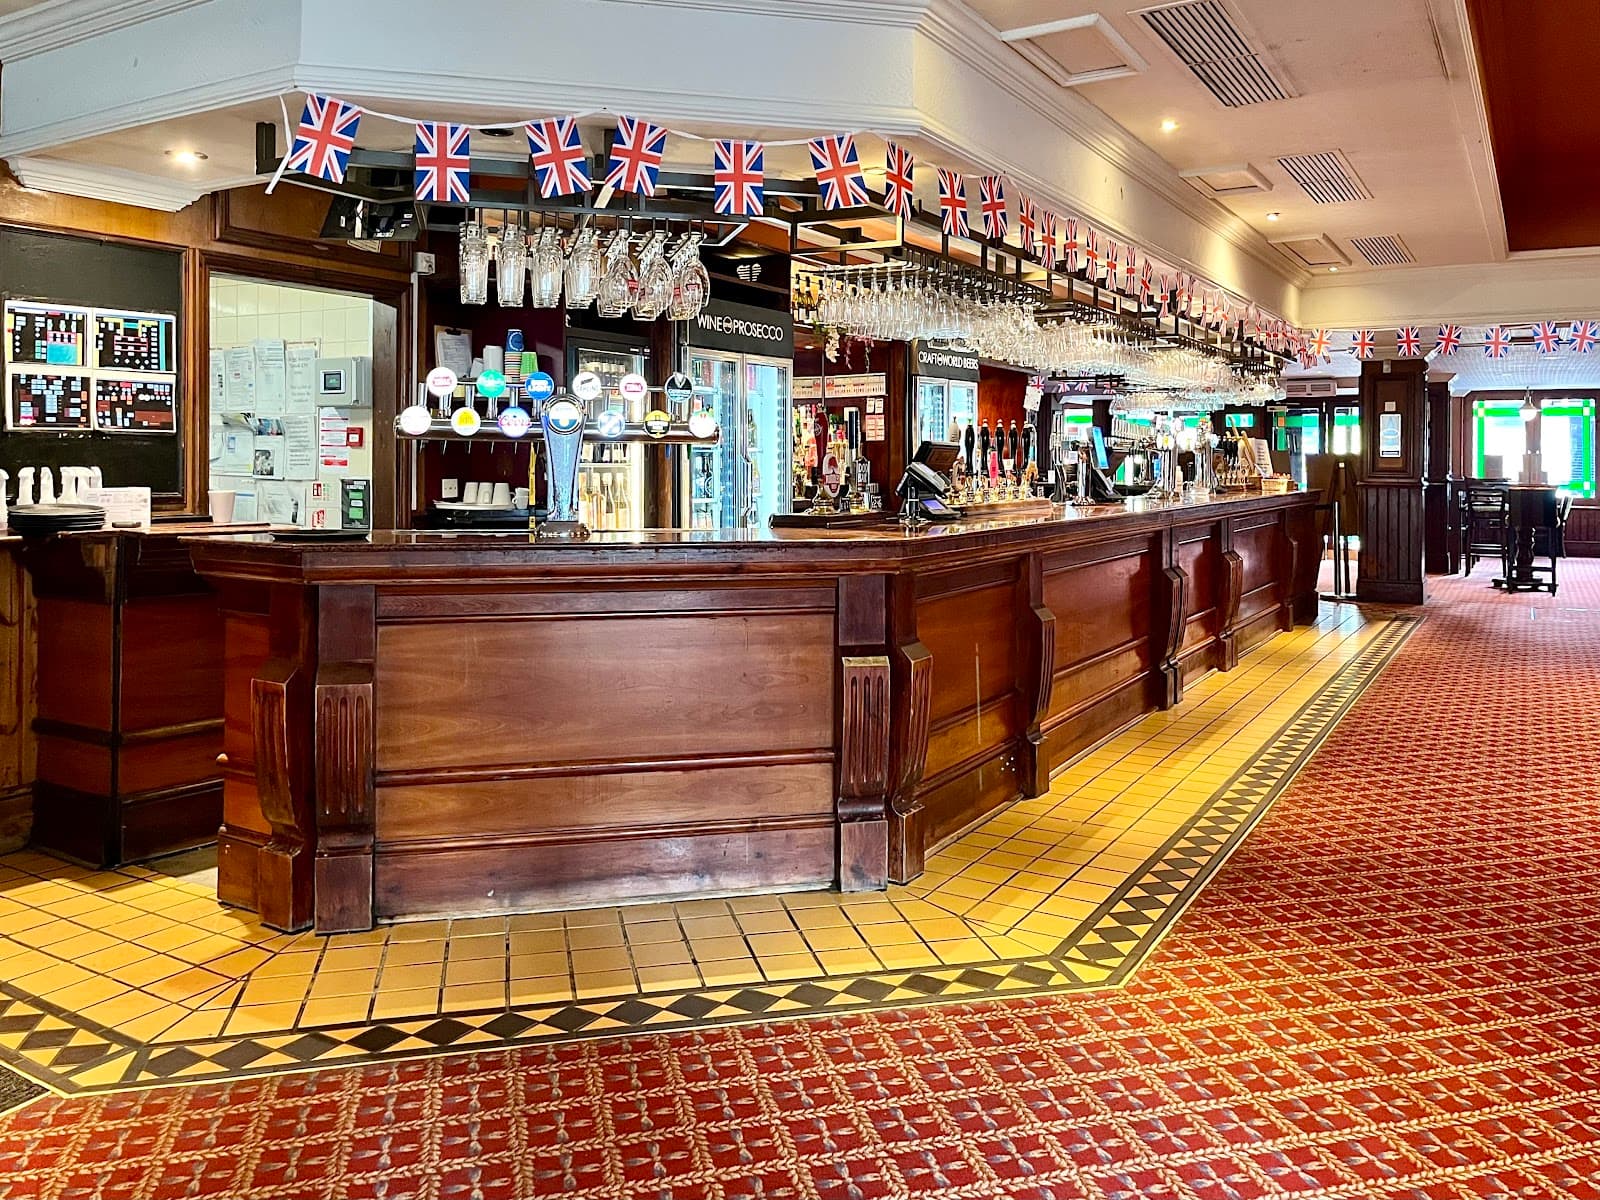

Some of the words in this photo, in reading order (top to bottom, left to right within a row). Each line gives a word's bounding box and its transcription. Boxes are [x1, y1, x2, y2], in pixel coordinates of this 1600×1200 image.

[697, 313, 723, 332] WINE
[733, 319, 784, 341] PROSECCO
[918, 351, 937, 365] CRAFT
[943, 354, 963, 368] WORLD
[963, 357, 979, 370] BEERS
